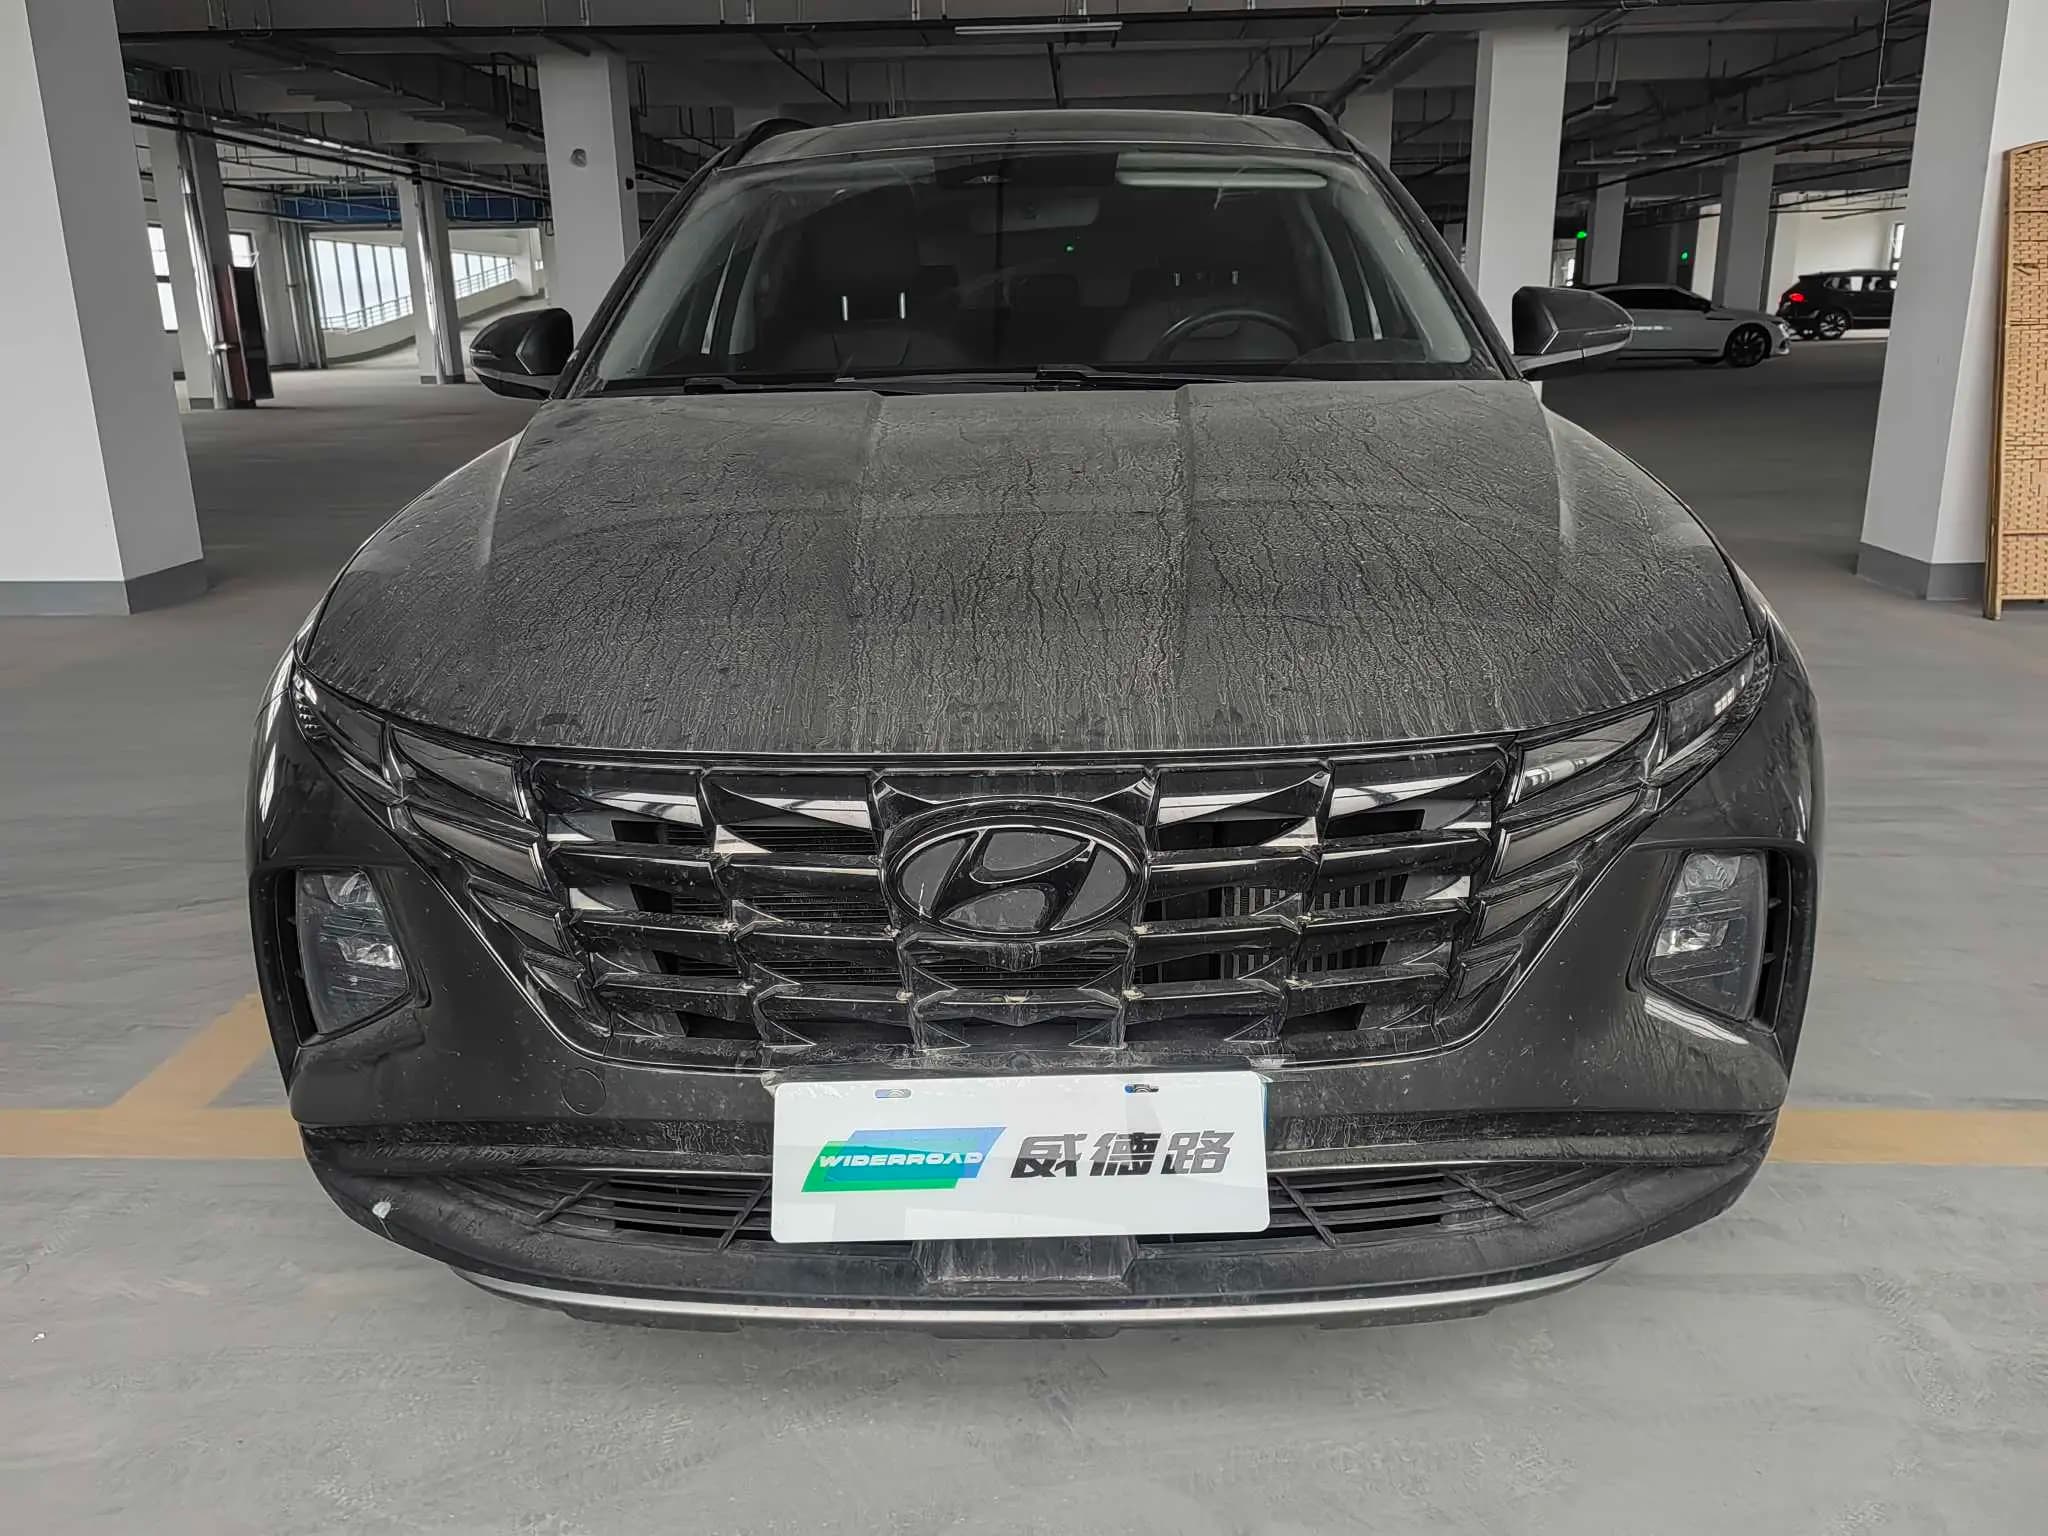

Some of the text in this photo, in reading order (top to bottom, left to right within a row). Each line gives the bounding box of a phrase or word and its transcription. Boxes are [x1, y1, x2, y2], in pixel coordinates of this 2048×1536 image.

[819, 1151, 984, 1168] WIDERROAD
[1010, 1130, 1235, 1179] 威德路
